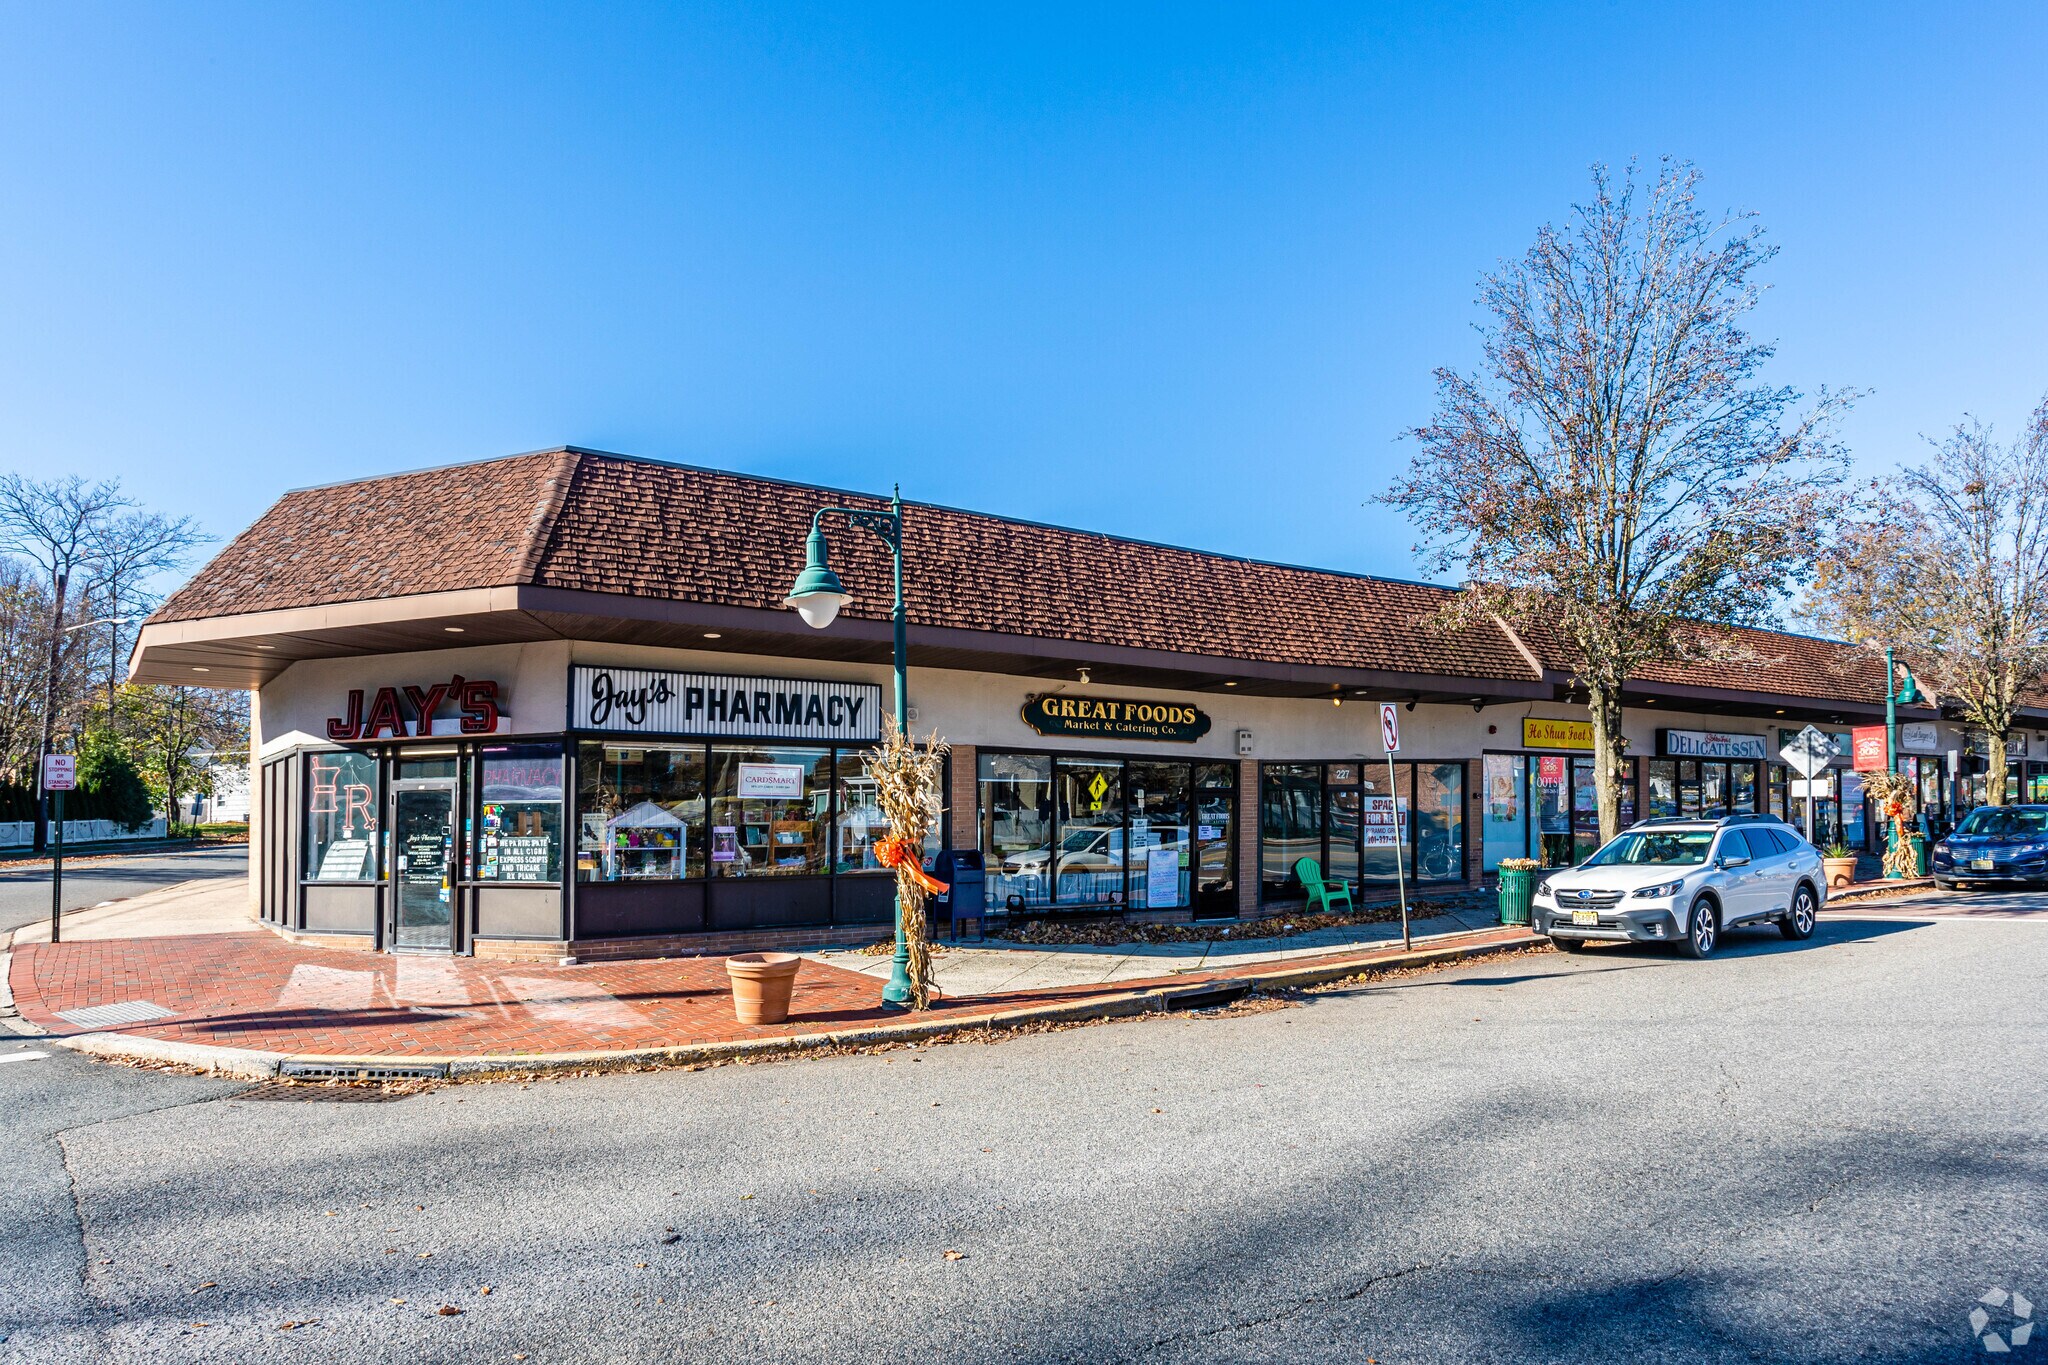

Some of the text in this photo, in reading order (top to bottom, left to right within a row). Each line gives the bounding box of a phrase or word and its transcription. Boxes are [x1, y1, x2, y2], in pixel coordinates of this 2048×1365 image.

[590, 672, 865, 728] Jay's PHARMACY
[327, 674, 498, 741] JAY'S
[1042, 698, 1197, 725] GREAT FOODS
[1064, 719, 1177, 735] Market & Catering Co.
[1528, 723, 1542, 739] Ho
[1544, 724, 1566, 740] Shun
[1568, 726, 1587, 741] Foot
[1669, 732, 1765, 758] DELICATESSEN
[483, 767, 562, 788] PHARMACY
[745, 775, 797, 785] CARDSMART
[1336, 769, 1350, 779] 227
[1372, 799, 1395, 811] SPAC
[1366, 813, 1404, 824] FOR RET
[500, 839, 508, 847] WE
[524, 856, 548, 864] SCRIPTS
[506, 872, 537, 880] RX PLANS
